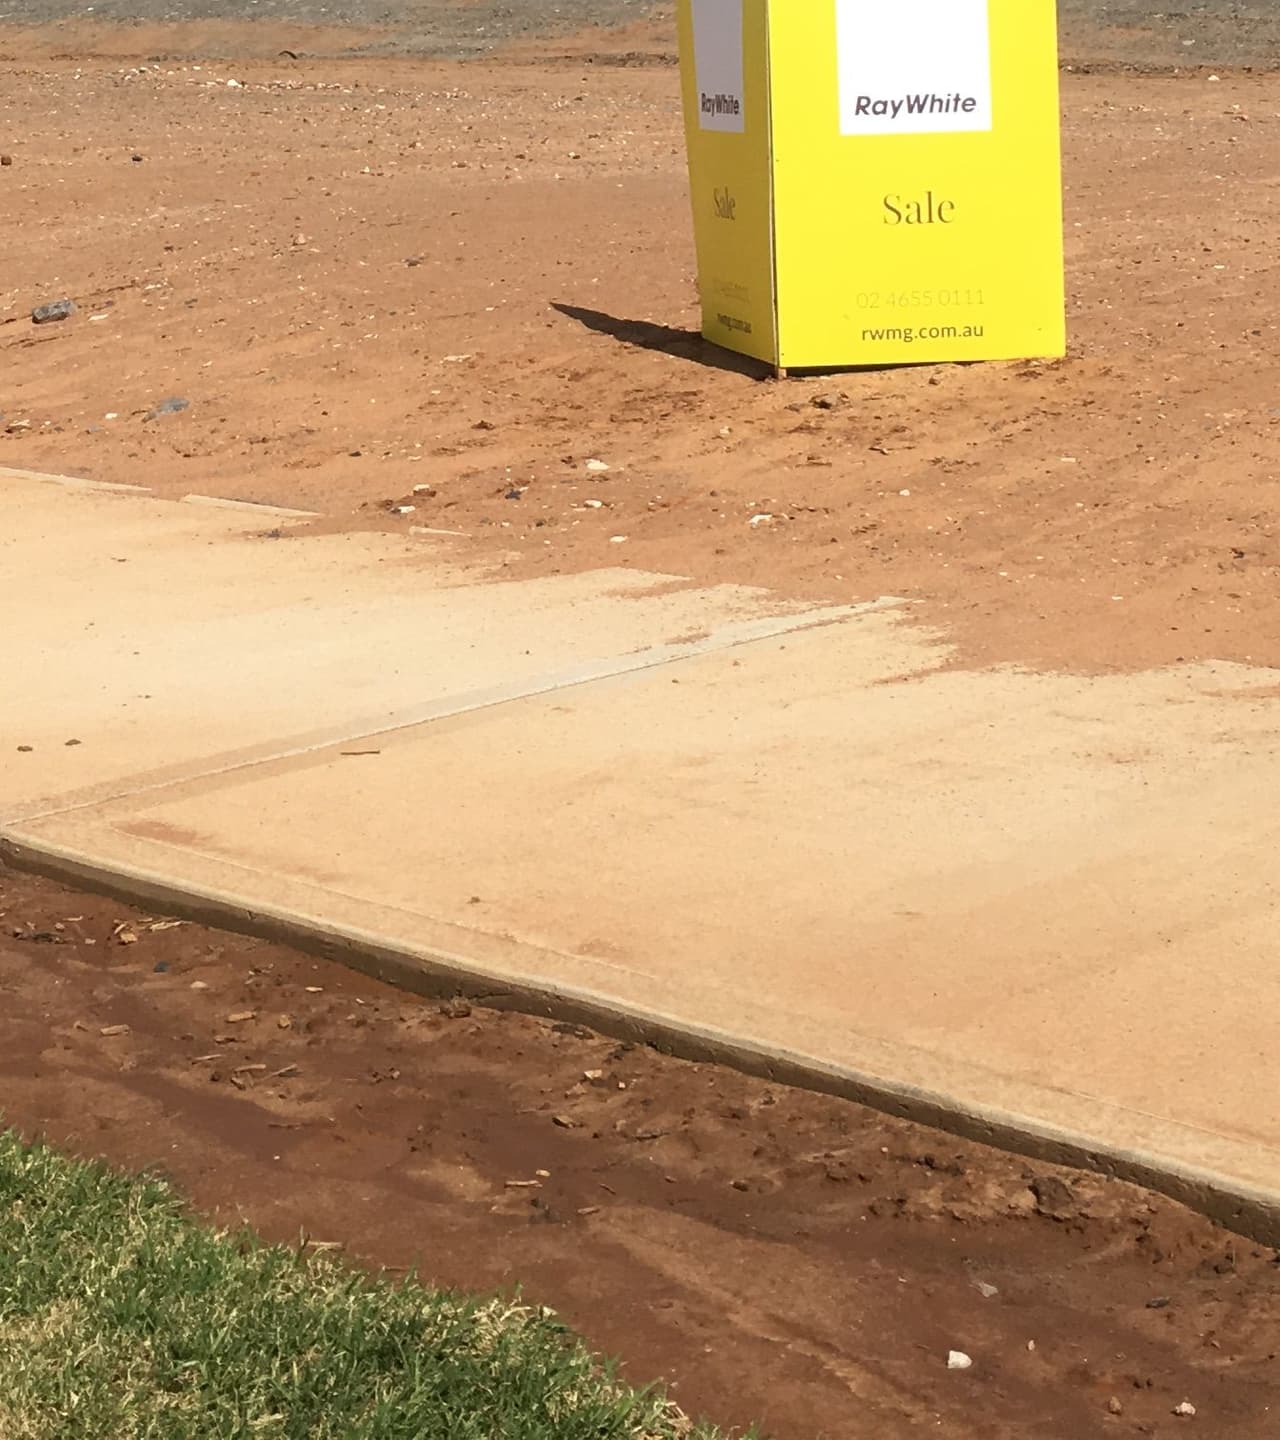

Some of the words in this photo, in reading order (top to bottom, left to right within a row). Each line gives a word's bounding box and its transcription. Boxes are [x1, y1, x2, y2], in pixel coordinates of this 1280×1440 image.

[714, 186, 736, 221] Sale
[883, 190, 956, 226] Sale
[856, 292, 880, 310] 02
[886, 290, 934, 309] 4655
[937, 289, 985, 308] 0111
[861, 325, 984, 344] rwmg.com.au
